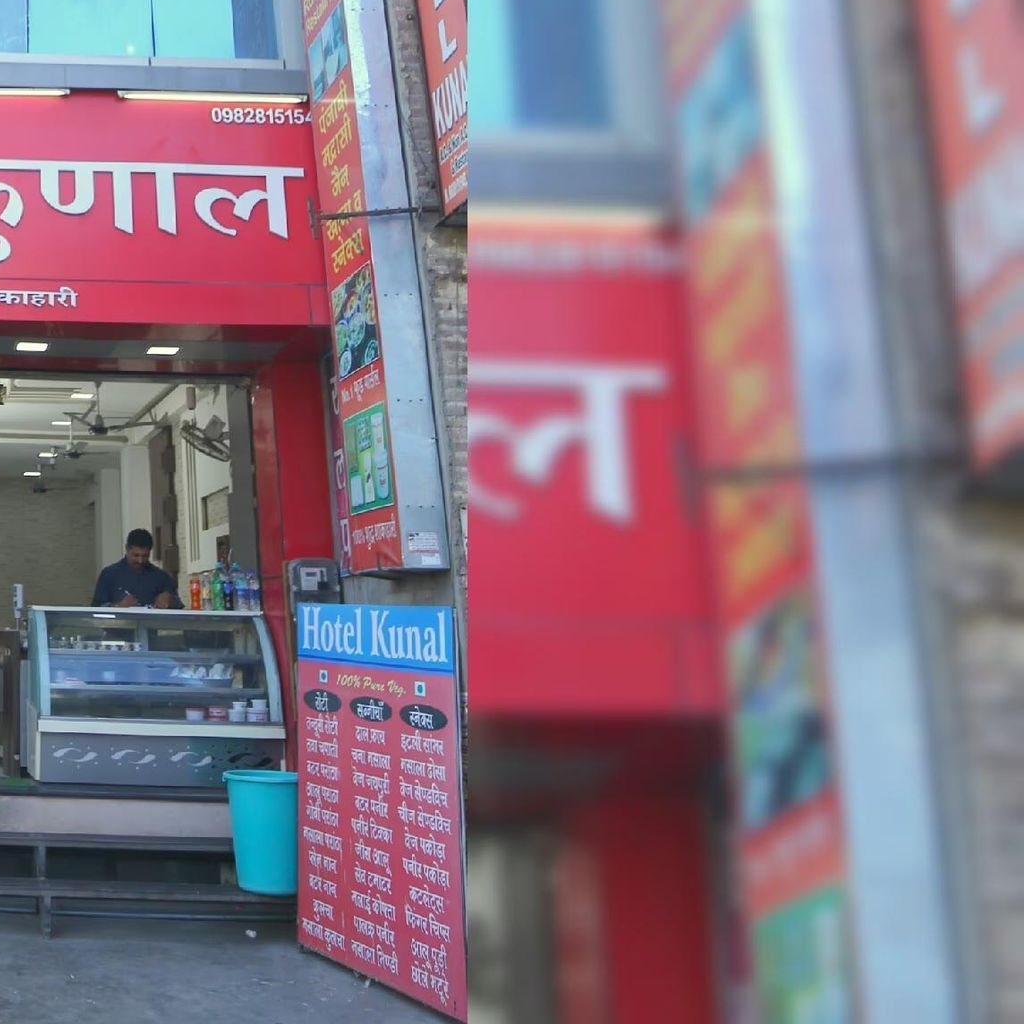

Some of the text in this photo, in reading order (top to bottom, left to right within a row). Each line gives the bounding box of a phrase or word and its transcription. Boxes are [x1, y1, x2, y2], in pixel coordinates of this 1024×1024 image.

[318, 79, 349, 134] पंजाबी
[431, 56, 467, 141] KUNA
[330, 163, 351, 197] जैन
[302, 606, 448, 663] Hotel Kunal
[336, 673, 361, 685] 100%
[362, 676, 385, 692] Pure
